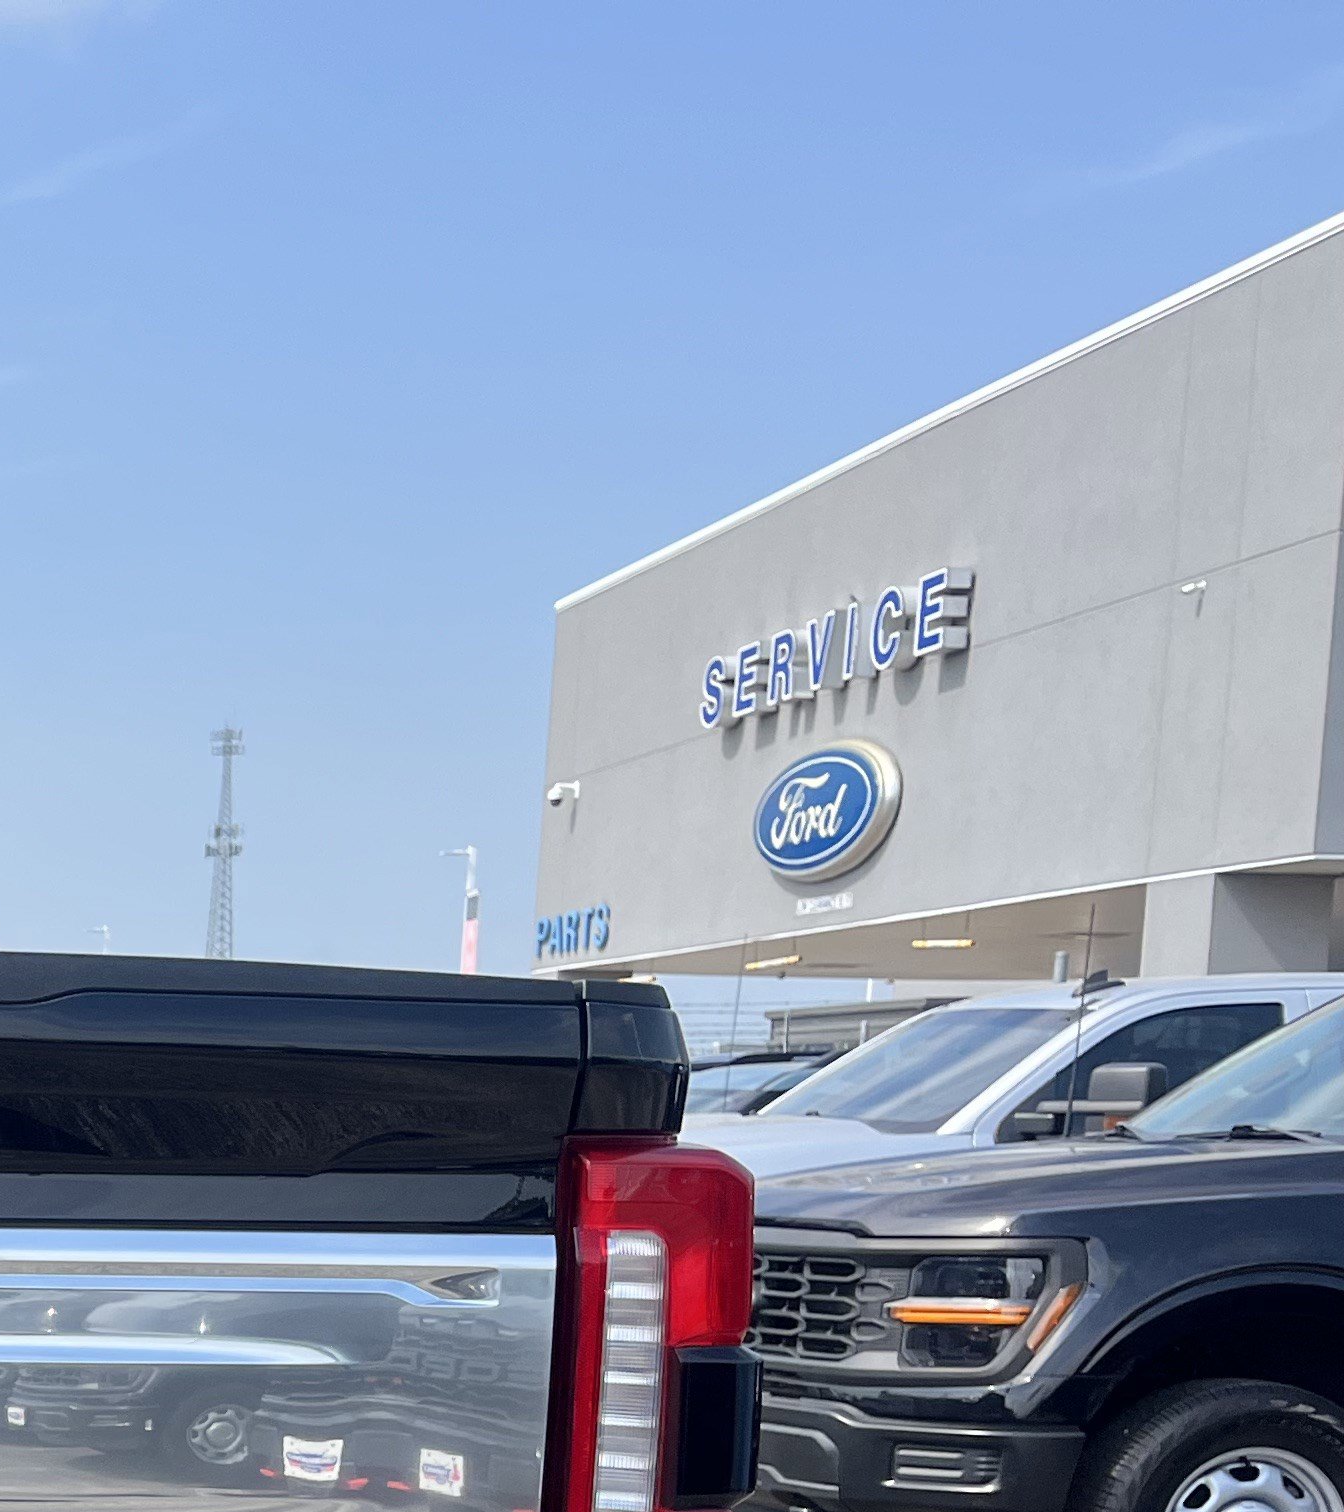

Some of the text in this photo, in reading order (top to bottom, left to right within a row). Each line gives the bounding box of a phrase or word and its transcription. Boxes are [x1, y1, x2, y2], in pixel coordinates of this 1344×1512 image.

[699, 567, 956, 729] SERVICE
[769, 772, 849, 850] Ford
[535, 902, 611, 958] PARTS
